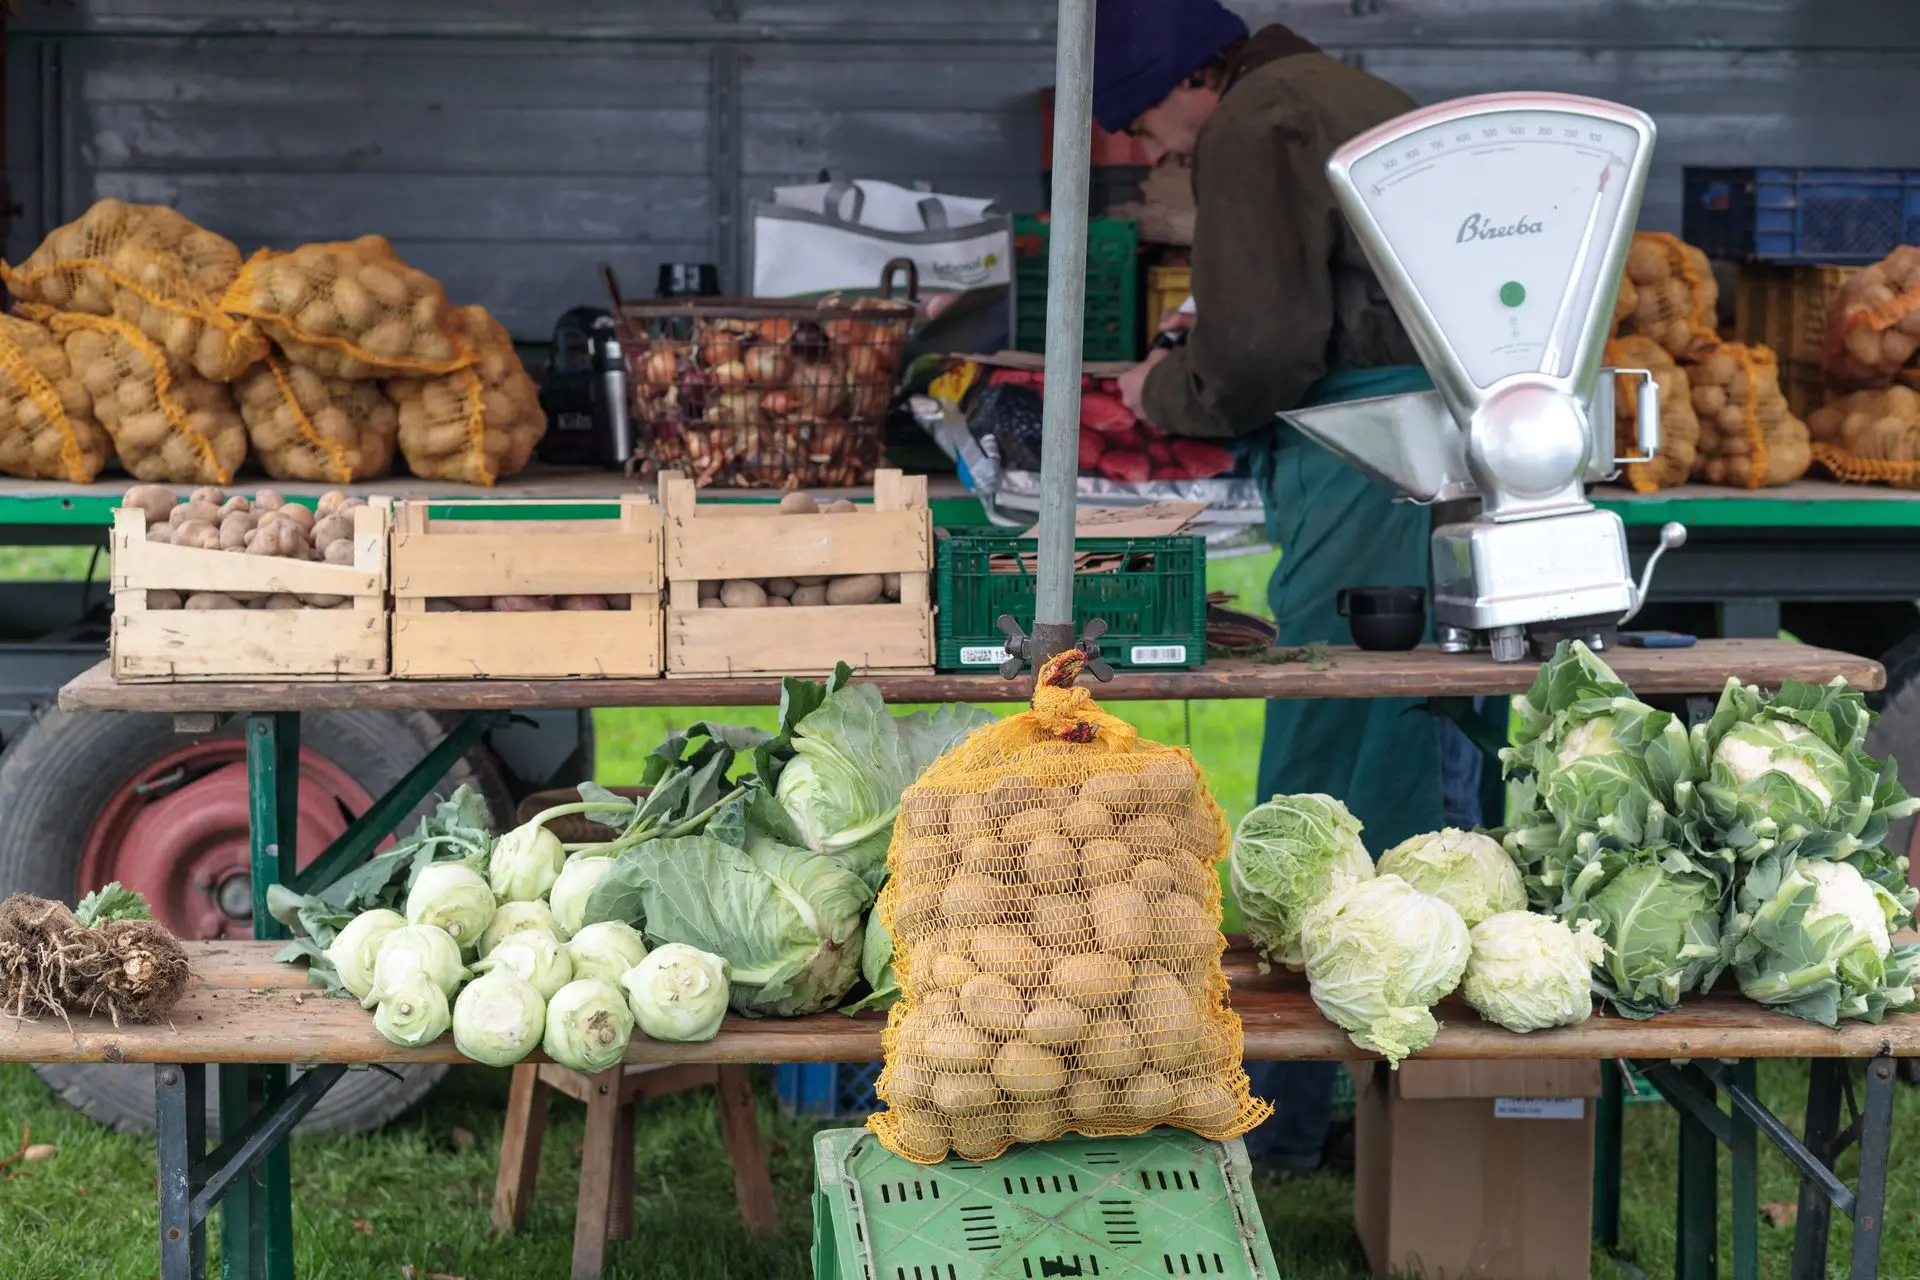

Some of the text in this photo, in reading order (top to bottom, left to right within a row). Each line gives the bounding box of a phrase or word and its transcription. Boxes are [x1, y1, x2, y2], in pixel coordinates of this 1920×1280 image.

[1509, 126, 1526, 136] 400
[1563, 128, 1579, 139] 200
[1589, 131, 1603, 142] 100
